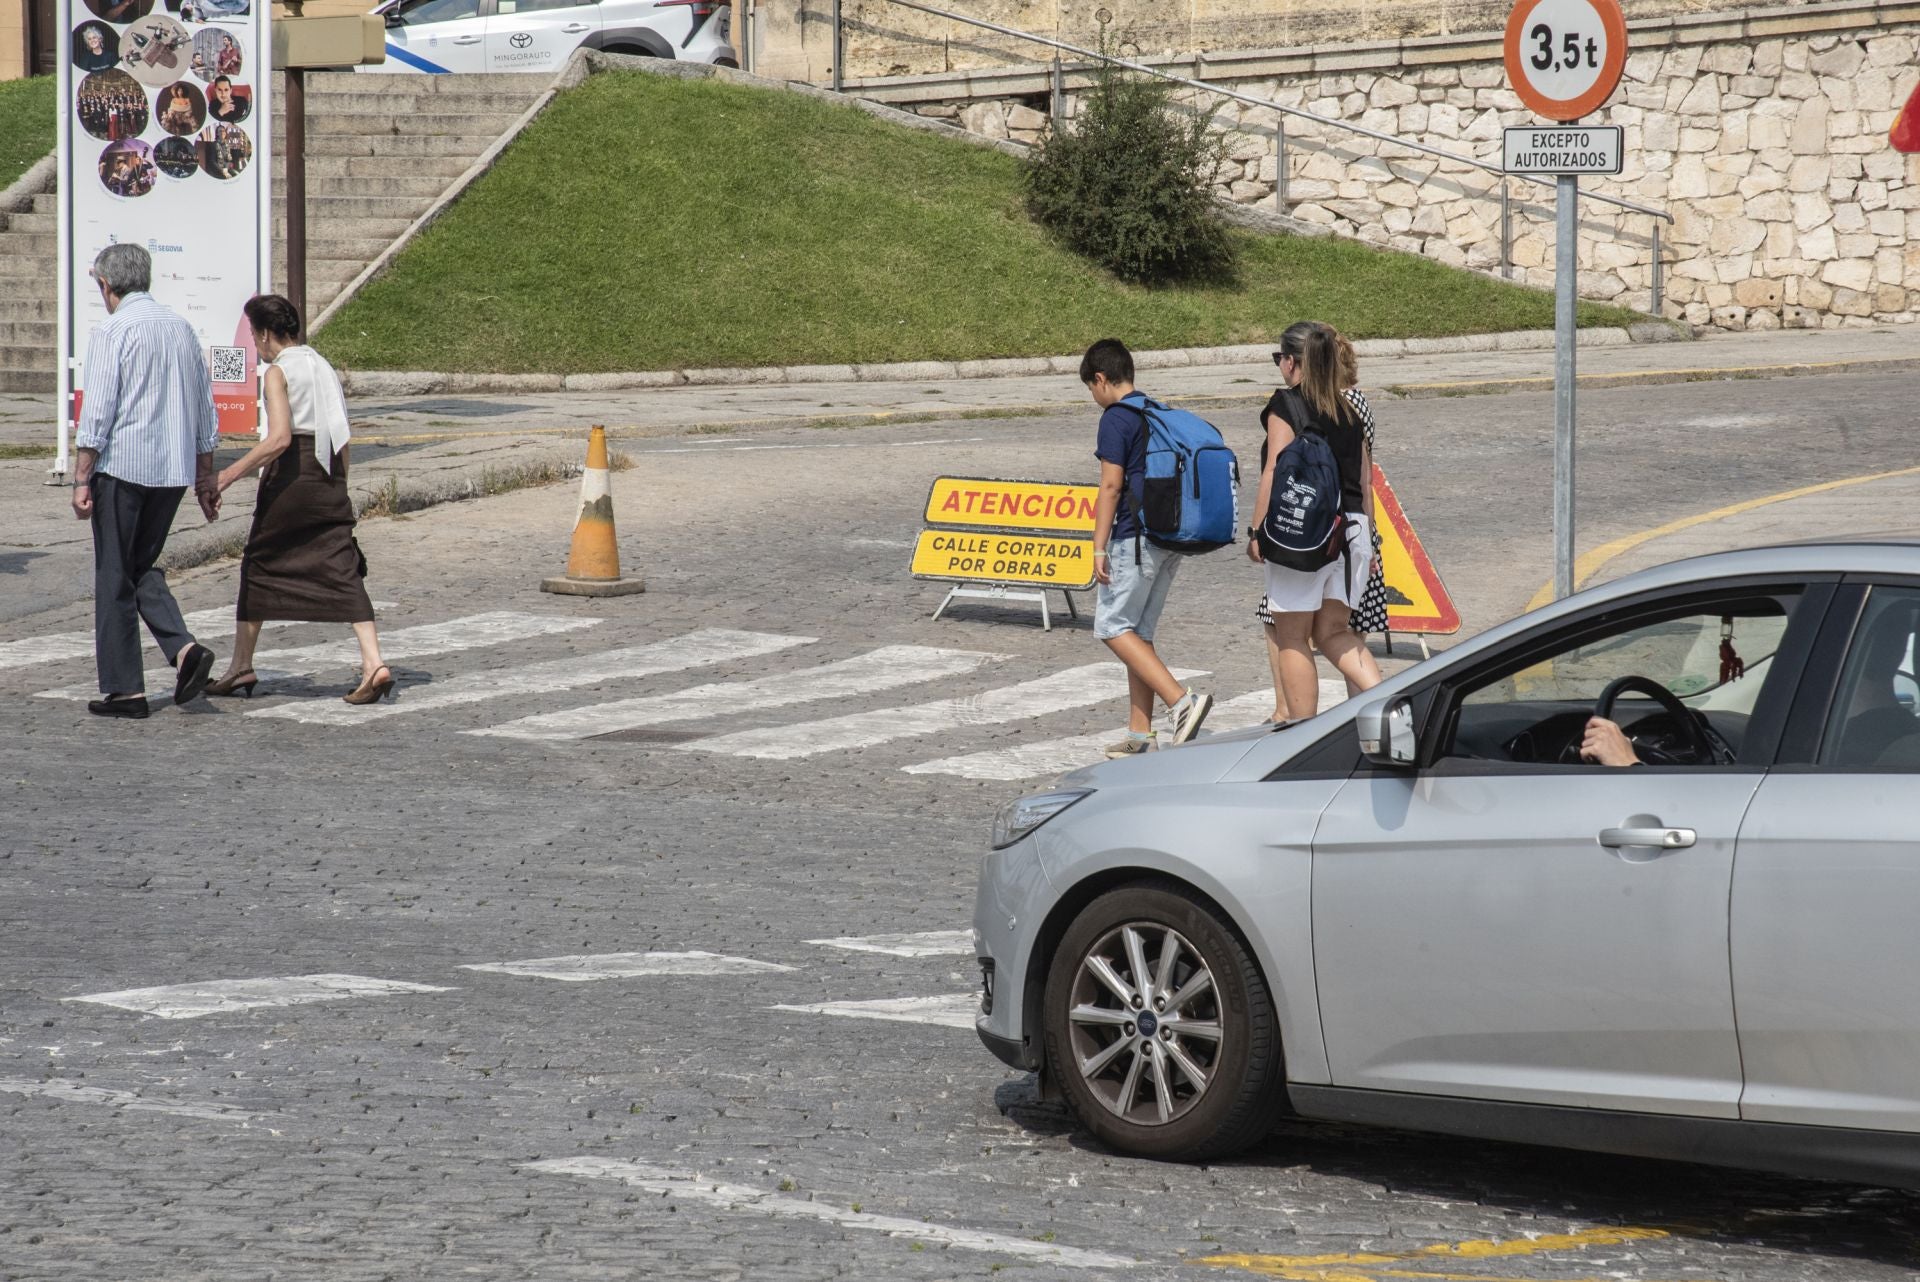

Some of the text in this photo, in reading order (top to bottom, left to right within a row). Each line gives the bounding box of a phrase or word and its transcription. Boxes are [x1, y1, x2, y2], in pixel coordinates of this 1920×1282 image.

[494, 51, 551, 61] MINGORAUTO
[1532, 133, 1590, 148] EXCEPTO
[1515, 152, 1607, 168] AUTORIZADOS
[158, 244, 183, 252] SEGOVIA
[942, 489, 1099, 520] ATENCIÓN
[932, 537, 1082, 559] CALLE CORTADA
[948, 557, 1057, 577] POR OBRAS
[1208, 936, 1241, 1011] MICHELIN
